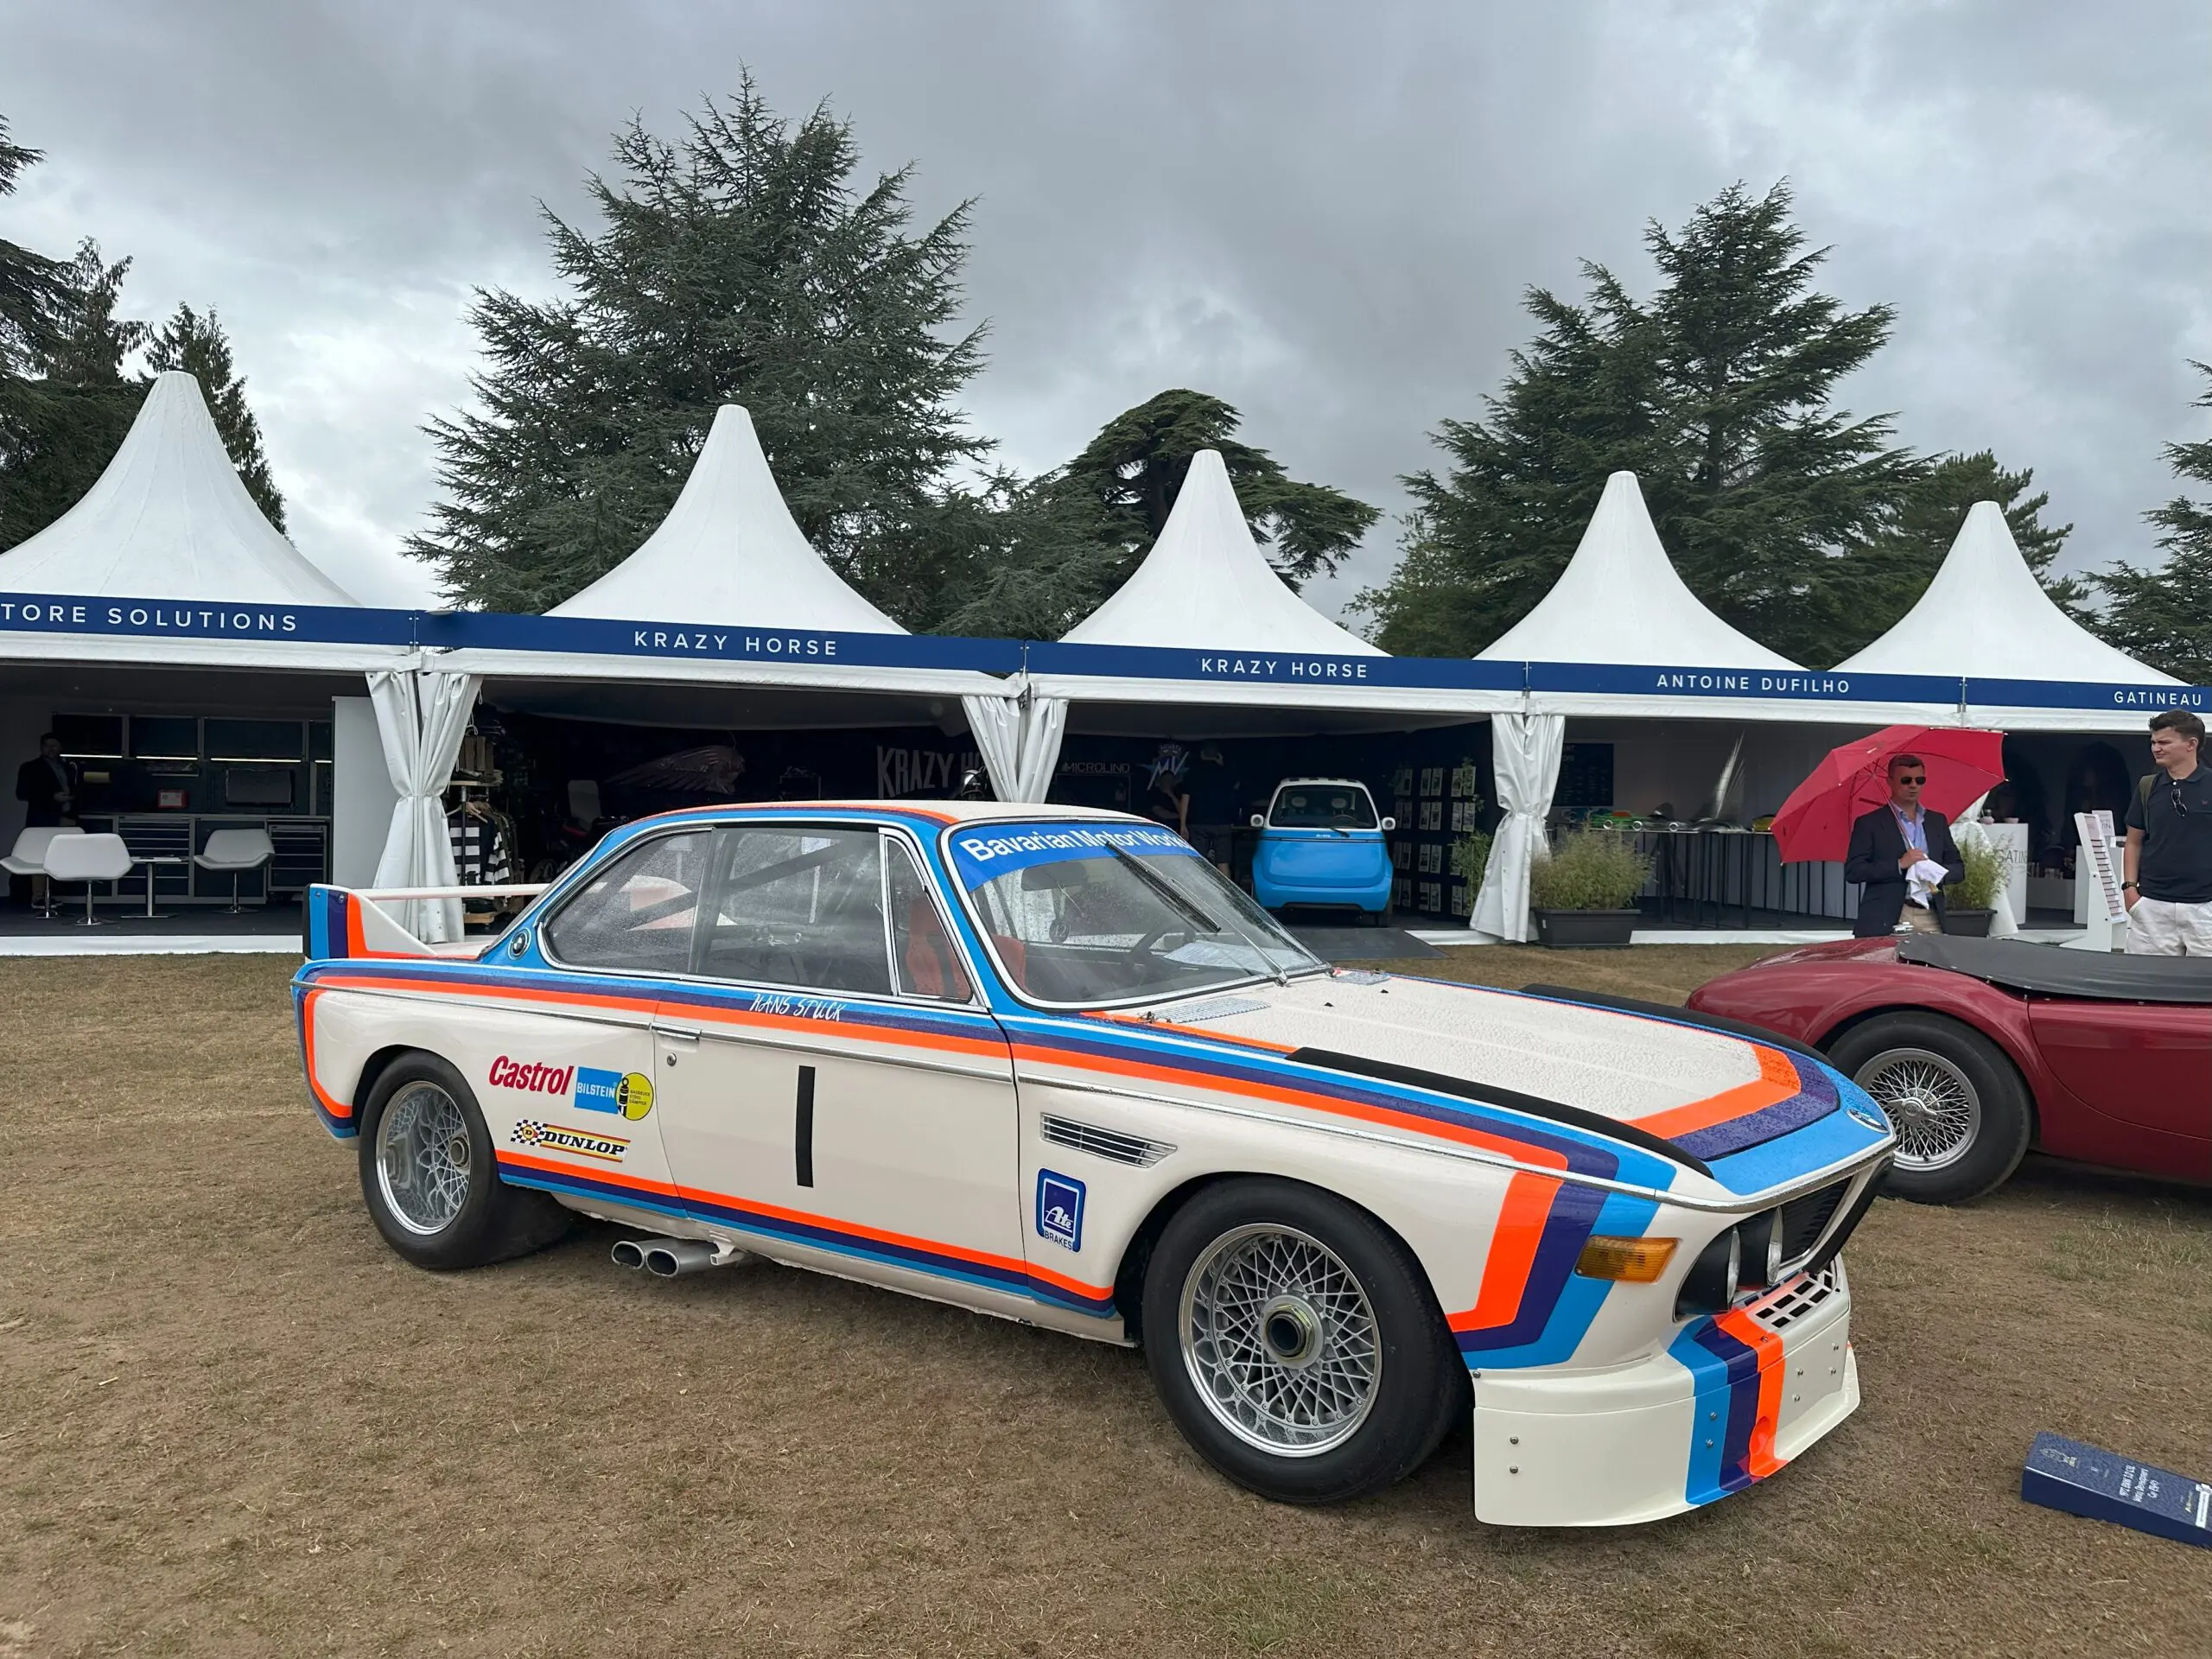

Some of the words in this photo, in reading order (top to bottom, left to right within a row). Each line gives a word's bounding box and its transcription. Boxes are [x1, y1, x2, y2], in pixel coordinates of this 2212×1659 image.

[1, 603, 86, 623] TORE
[108, 607, 296, 632] SOLUTIONS
[634, 631, 728, 651] KRAZY
[746, 636, 836, 656] HORSE
[1201, 658, 1277, 674] KRAZY
[1292, 662, 1367, 677] HORSE
[1656, 674, 1750, 690] ANTOINE
[1761, 677, 1849, 693] DUFILHO
[2113, 690, 2202, 706] GATINEAU
[876, 745, 955, 799] KRAZY
[1064, 761, 1130, 774] MICROLINO
[959, 830, 1075, 862] Bavarian
[1071, 830, 1135, 848] Motor
[489, 1055, 574, 1095] Castrol
[577, 1082, 615, 1098] BILSTEIN
[795, 1065, 816, 1188] 1
[543, 1129, 626, 1155] DUNLOP
[1044, 1230, 1073, 1251] BRAKES
